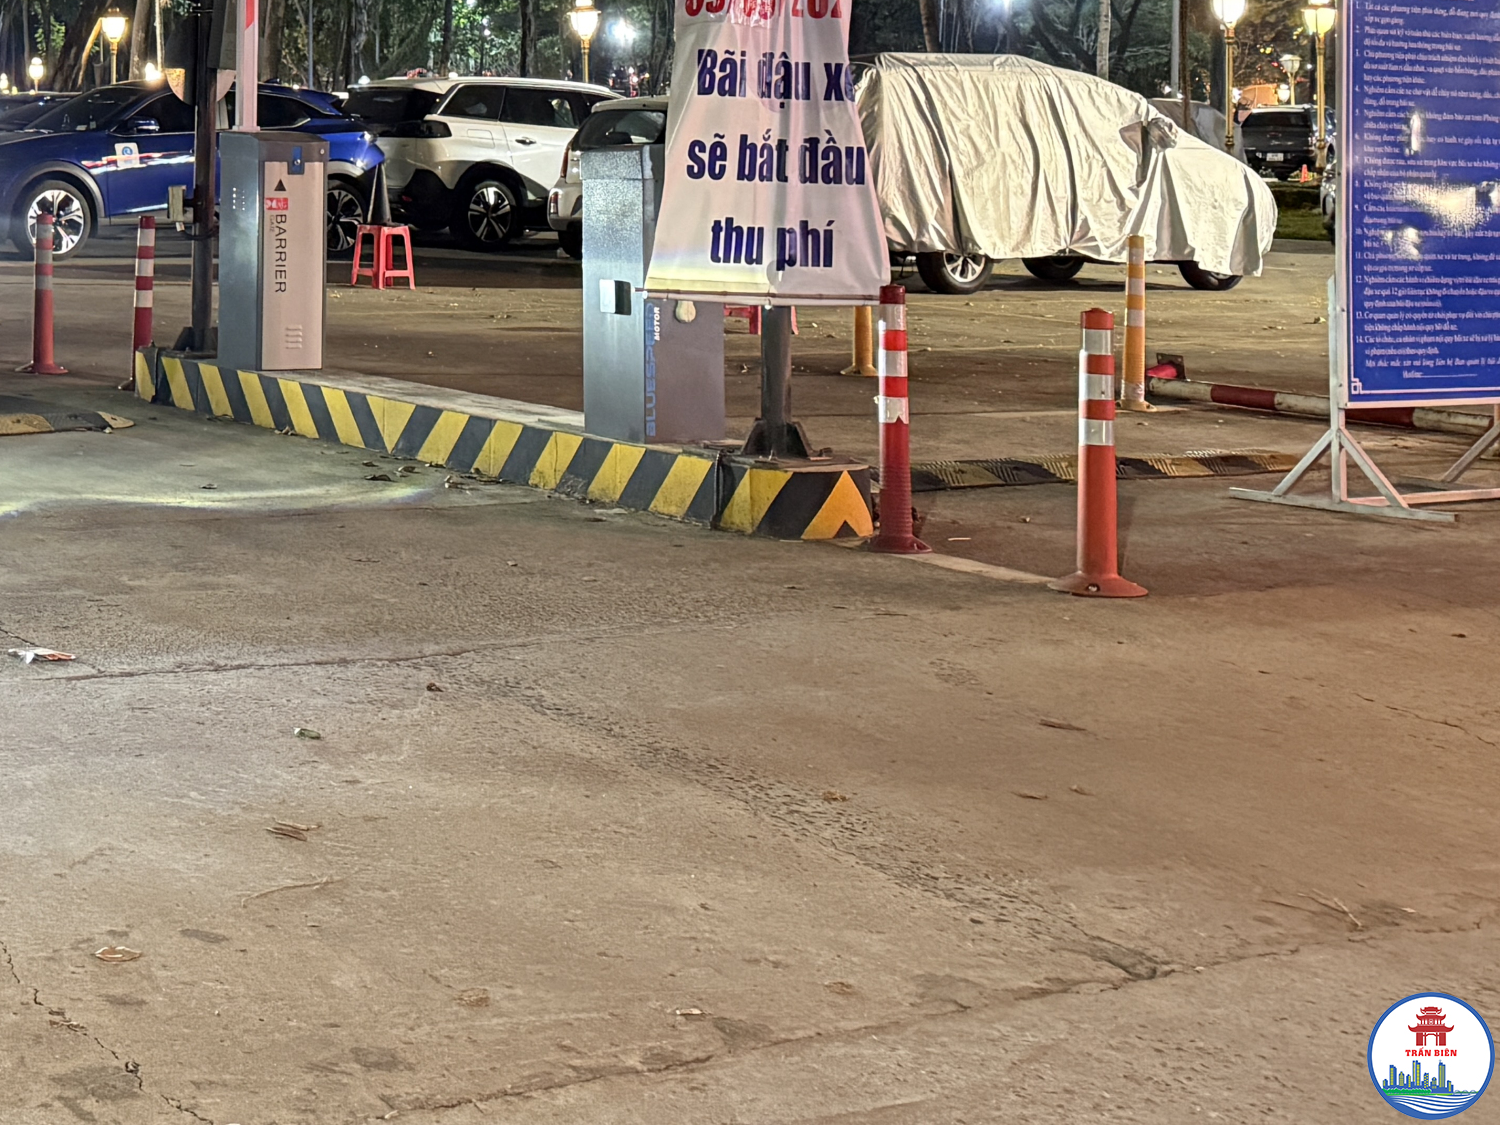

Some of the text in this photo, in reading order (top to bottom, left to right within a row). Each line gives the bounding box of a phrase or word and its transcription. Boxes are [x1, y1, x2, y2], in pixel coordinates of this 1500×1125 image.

[697, 49, 747, 98] Bãi
[757, 51, 811, 109] đậu
[686, 128, 865, 185] sẽ bắt đầu
[275, 214, 287, 293] BARRIER
[710, 217, 835, 271] thu phí
[653, 306, 661, 341] MOTOR
